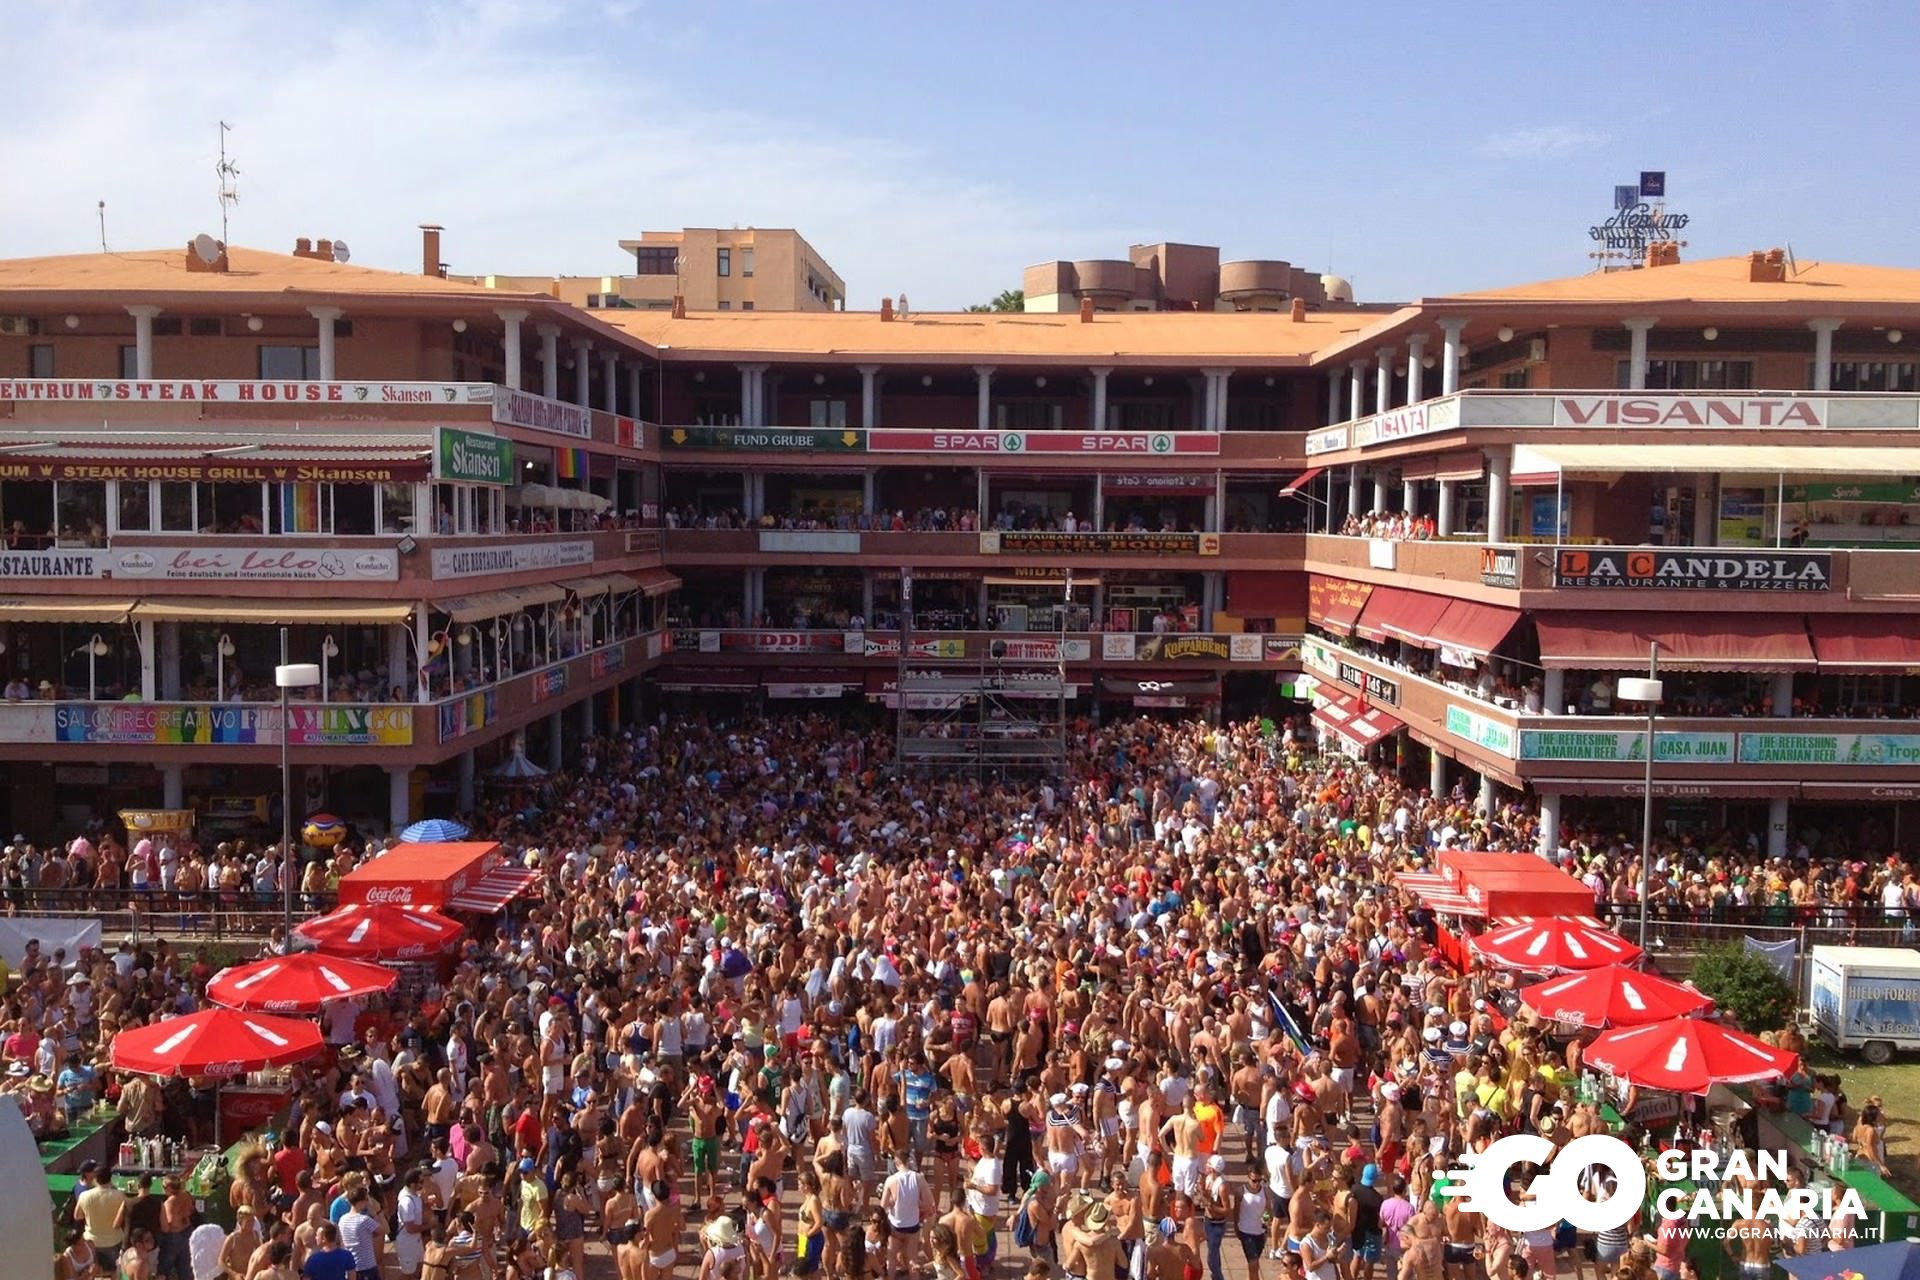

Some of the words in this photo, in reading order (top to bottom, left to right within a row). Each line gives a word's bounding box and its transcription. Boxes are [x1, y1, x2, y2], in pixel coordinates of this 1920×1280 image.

[116, 384, 218, 400] STEAK
[239, 385, 343, 400] HOUSE
[382, 385, 432, 402] Skansen
[1560, 400, 1821, 426] VISANTA
[734, 434, 768, 446] FUND
[772, 435, 814, 447] GRUBE
[934, 435, 998, 449] SPAR
[1082, 436, 1147, 449] SPAR
[452, 441, 501, 478] Skansen
[63, 466, 128, 478] STEAK
[134, 466, 202, 478] HOUSE
[208, 467, 265, 479] GRILL
[297, 466, 391, 480] Skansen
[168, 550, 230, 569] bei
[1562, 551, 1619, 578] LA
[1628, 552, 1826, 580] CANDELA
[1562, 577, 1706, 588] RESTAURANTE
[1718, 579, 1728, 588] &
[1740, 580, 1830, 591] PIZZERIA
[1164, 639, 1228, 659] KOPPARBERG
[906, 670, 943, 679] BAR
[123, 709, 236, 729] RECREATIVO
[241, 708, 410, 730] FLAMINGO
[1538, 734, 1554, 745] THE
[1558, 734, 1618, 746] REFRESHING
[1759, 736, 1771, 748] THE
[1778, 737, 1838, 749] REFRESHING
[1538, 746, 1592, 758] CANARIAN
[1594, 747, 1617, 759] BEER
[1660, 741, 1691, 756] CASA
[1695, 741, 1728, 756] JUAN
[1759, 749, 1807, 761] CANARIAN
[1814, 750, 1836, 762] BEER
[1669, 785, 1711, 795] Juan
[1871, 787, 1913, 797] Casa
[366, 886, 413, 903] Coca-Cola
[1849, 986, 1880, 1000] HIELO
